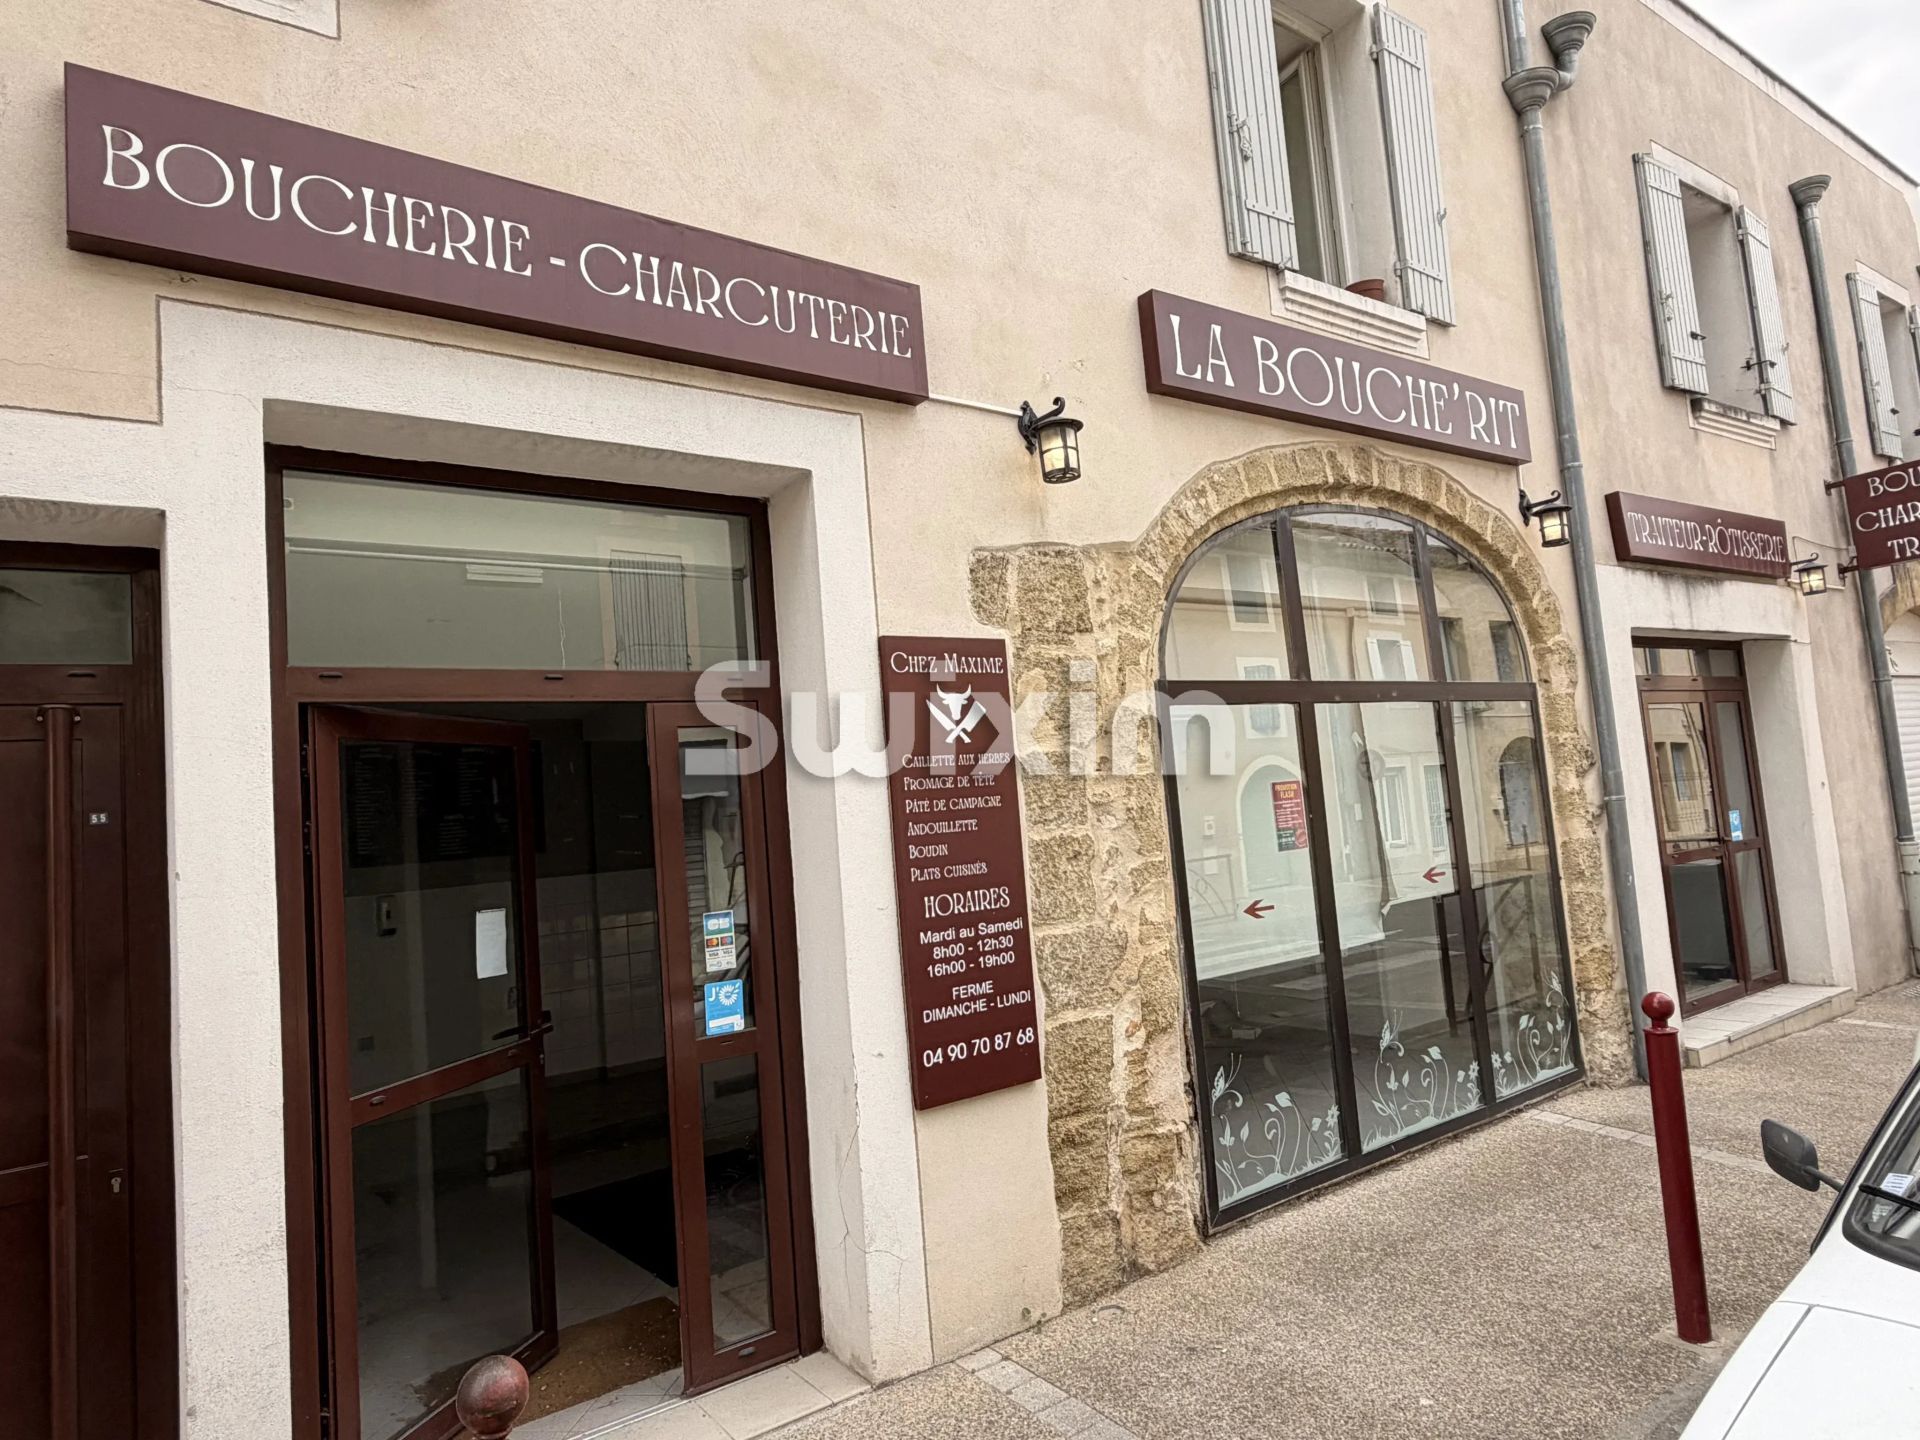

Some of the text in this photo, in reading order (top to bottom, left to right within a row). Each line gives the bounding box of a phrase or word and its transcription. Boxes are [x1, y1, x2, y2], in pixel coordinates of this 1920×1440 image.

[102, 124, 913, 358] BOUCHERIE - CHARCUTERIE
[1170, 313, 1520, 449] LA BOUCHE'RIT
[1627, 511, 1786, 564] TRAITEUR-RÔTISSERIE
[1887, 536, 1920, 560] TR
[890, 651, 1004, 674] CHEZ MAXIME
[902, 752, 1011, 768] CAILLETTE AUX HERBES
[904, 771, 995, 791] FROMAGE DE TÊTE
[905, 795, 1002, 814] PÂTÉ DE CAMPAGNE
[907, 819, 978, 836] ANDOUILLETTE
[908, 843, 949, 859] BOUDIN
[910, 860, 988, 882] PLATS CUISINÉS
[924, 886, 1010, 918] HORAIRES
[919, 917, 1023, 945] Mardi au Samedi
[932, 944, 965, 960] 8h00
[976, 935, 1014, 952] 12h30
[927, 960, 966, 978] 16h00
[978, 951, 1015, 968] 19h00
[952, 980, 994, 1000] FERME
[923, 999, 987, 1023] DIMANCHE
[997, 989, 1031, 1009] LUNDI
[923, 1026, 1035, 1068] 04 90 70 87 68
